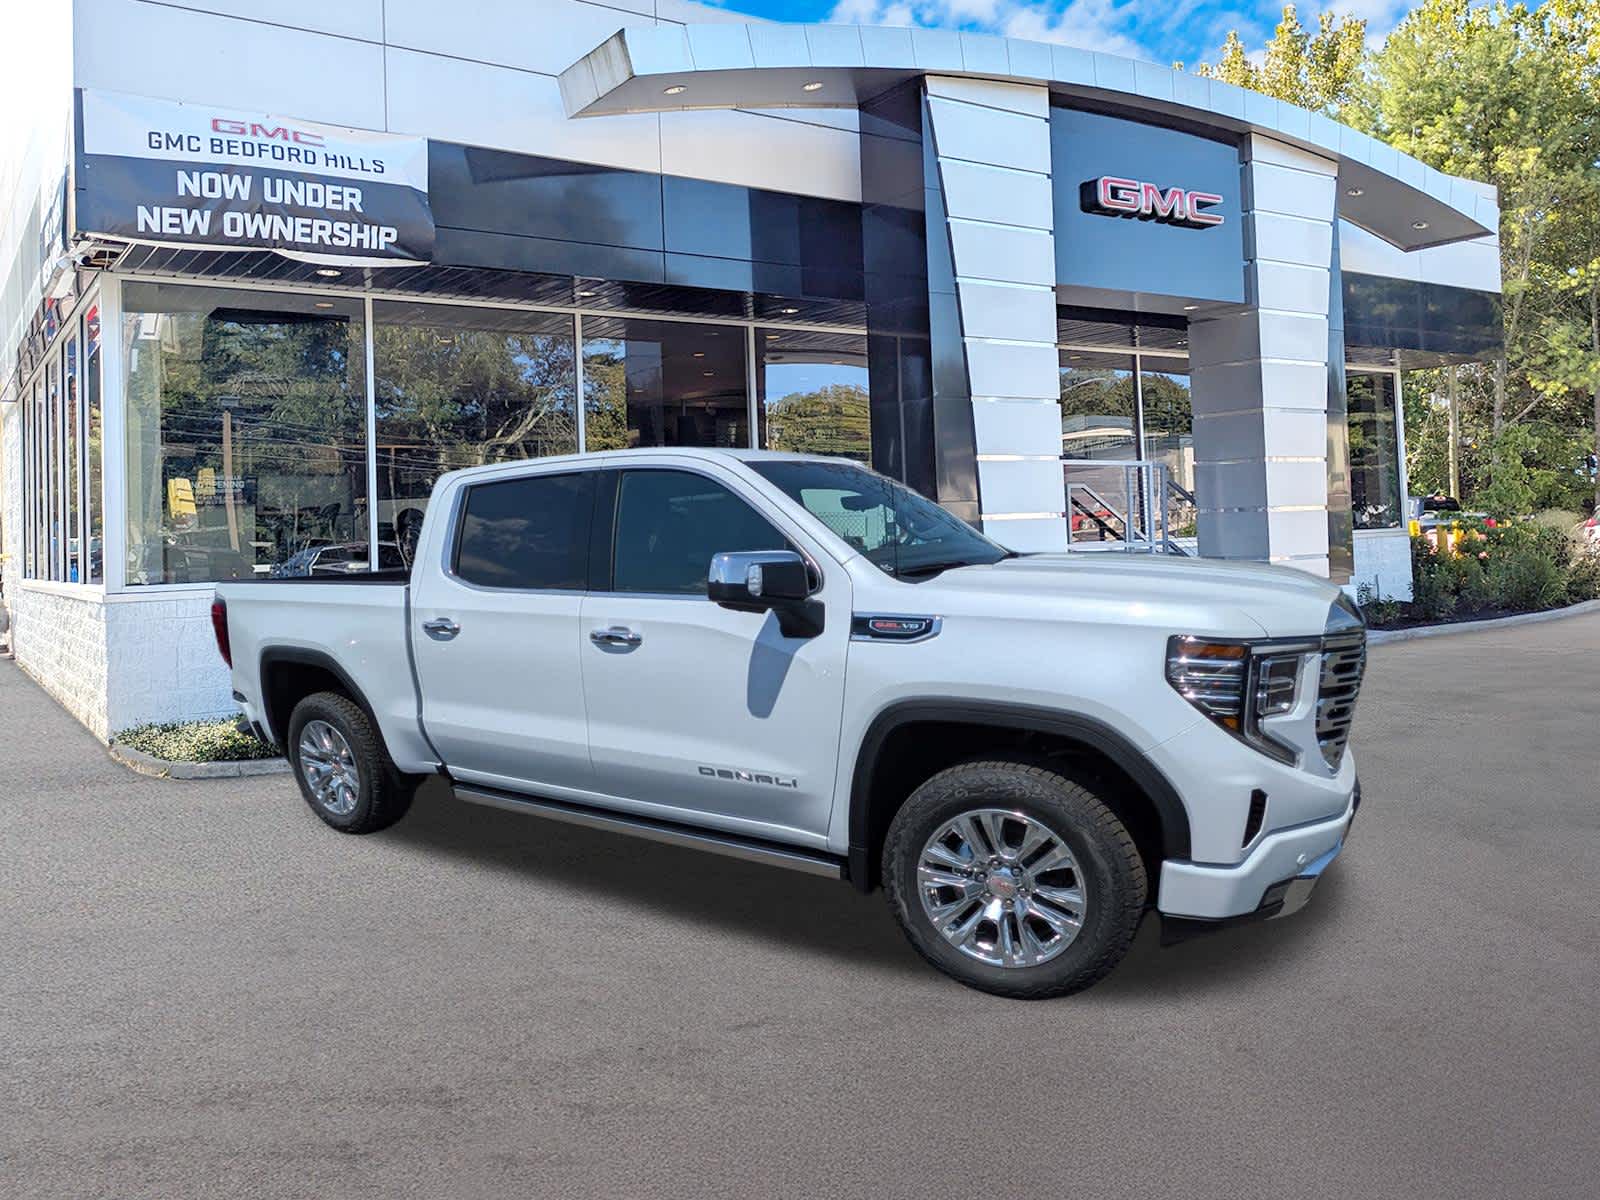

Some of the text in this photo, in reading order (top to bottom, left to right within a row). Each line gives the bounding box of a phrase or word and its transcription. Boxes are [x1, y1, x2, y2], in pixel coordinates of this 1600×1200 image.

[148, 131, 385, 174] GMC BEDFORD HILLS
[211, 118, 325, 148] GMC
[177, 170, 363, 213] NOW UNDER
[1094, 175, 1225, 226] GMC
[137, 205, 398, 250] NEW OWNERSHIP
[698, 766, 798, 788] DENALI
